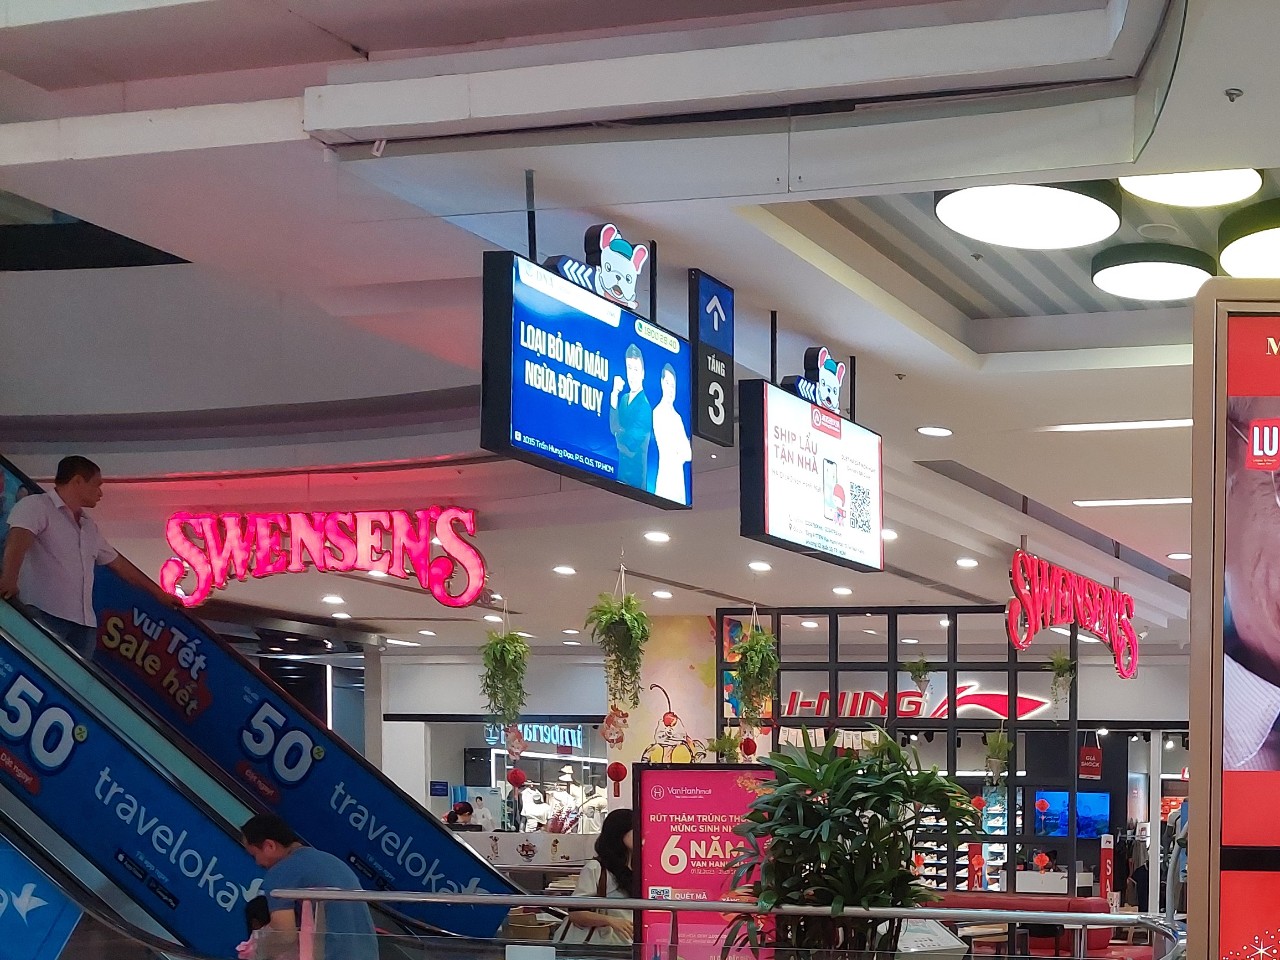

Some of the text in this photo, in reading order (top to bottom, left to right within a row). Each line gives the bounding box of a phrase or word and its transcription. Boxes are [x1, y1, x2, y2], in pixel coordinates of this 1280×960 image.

[520, 321, 609, 382] LOẠI BỎ MỠ MÁU
[706, 354, 726, 378] TẦNG
[525, 360, 557, 396] NGỪA
[558, 373, 580, 405] ĐỘT
[708, 381, 725, 425] 3
[774, 425, 797, 442] SHIP
[1253, 426, 1279, 457] LU
[774, 444, 795, 465] TẬN
[797, 454, 818, 475] NHÀ
[160, 505, 485, 608] SWENSEN'S
[133, 607, 207, 680] vui Tết
[102, 617, 198, 716] Sale hết
[782, 691, 924, 717] I-NING
[330, 781, 459, 893] traveloka
[650, 813, 667, 822] RÚT
[669, 813, 695, 822] THĂM
[696, 813, 727, 822] TRÚNG
[670, 823, 697, 832] MỪNG
[95, 766, 239, 913] traveloka
[661, 835, 745, 875] 6 NĂM
